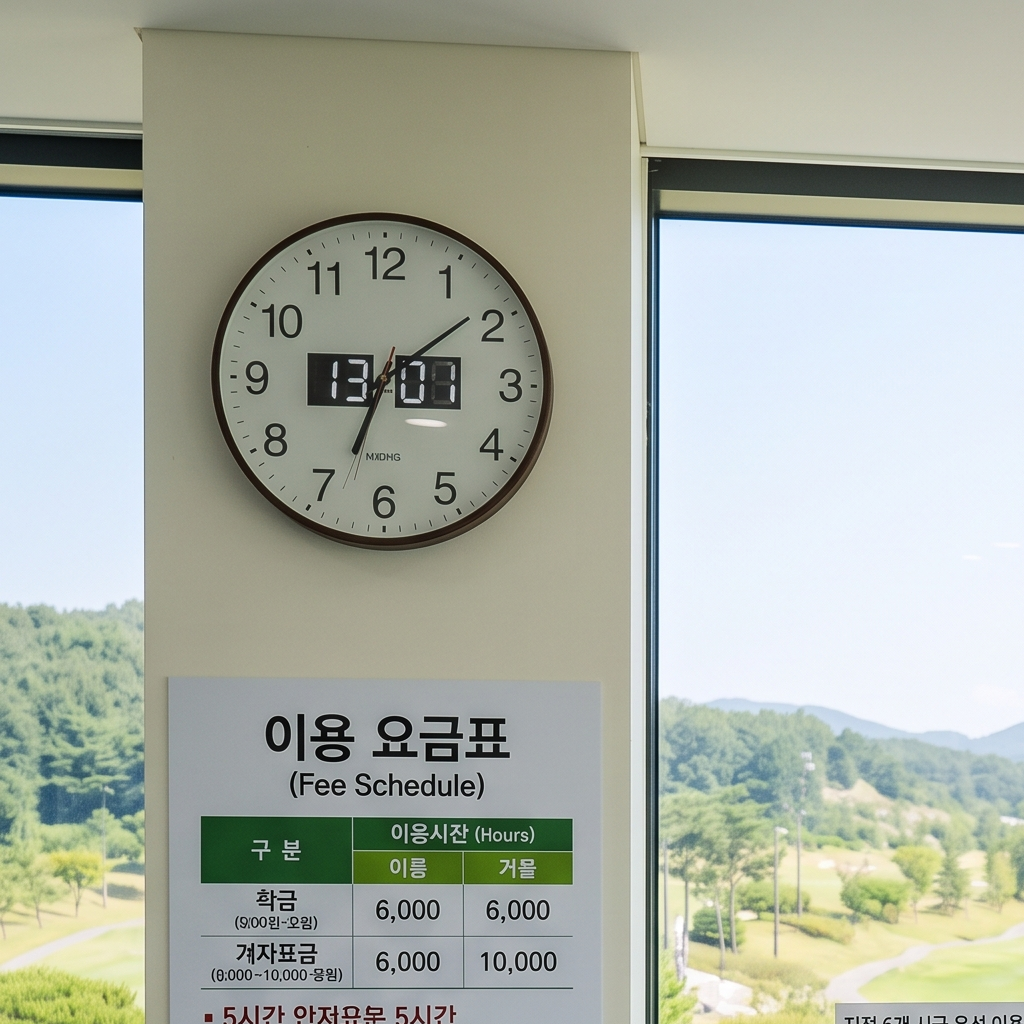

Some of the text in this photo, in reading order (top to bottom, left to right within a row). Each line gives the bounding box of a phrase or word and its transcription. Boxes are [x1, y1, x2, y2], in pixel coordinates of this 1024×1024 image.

[308, 261, 339, 295] 11
[365, 246, 405, 280] 12
[439, 265, 451, 298] 1
[262, 304, 302, 338] 10
[482, 309, 504, 342] 2
[246, 361, 268, 395] 9
[332, 359, 368, 402] 13
[499, 369, 522, 402] 3
[264, 423, 287, 456] 8
[480, 428, 503, 461] 4
[313, 469, 335, 501] 7
[373, 485, 395, 518] 6
[434, 472, 456, 505] 5
[266, 714, 510, 762] 이용 요금표
[290, 771, 484, 799] (Fee Schedule)
[475, 826, 534, 844] (Hours)
[376, 900, 440, 923] 6,000
[487, 900, 549, 923] 6,000
[376, 952, 440, 975] 6,000
[481, 952, 556, 975] 10,000
